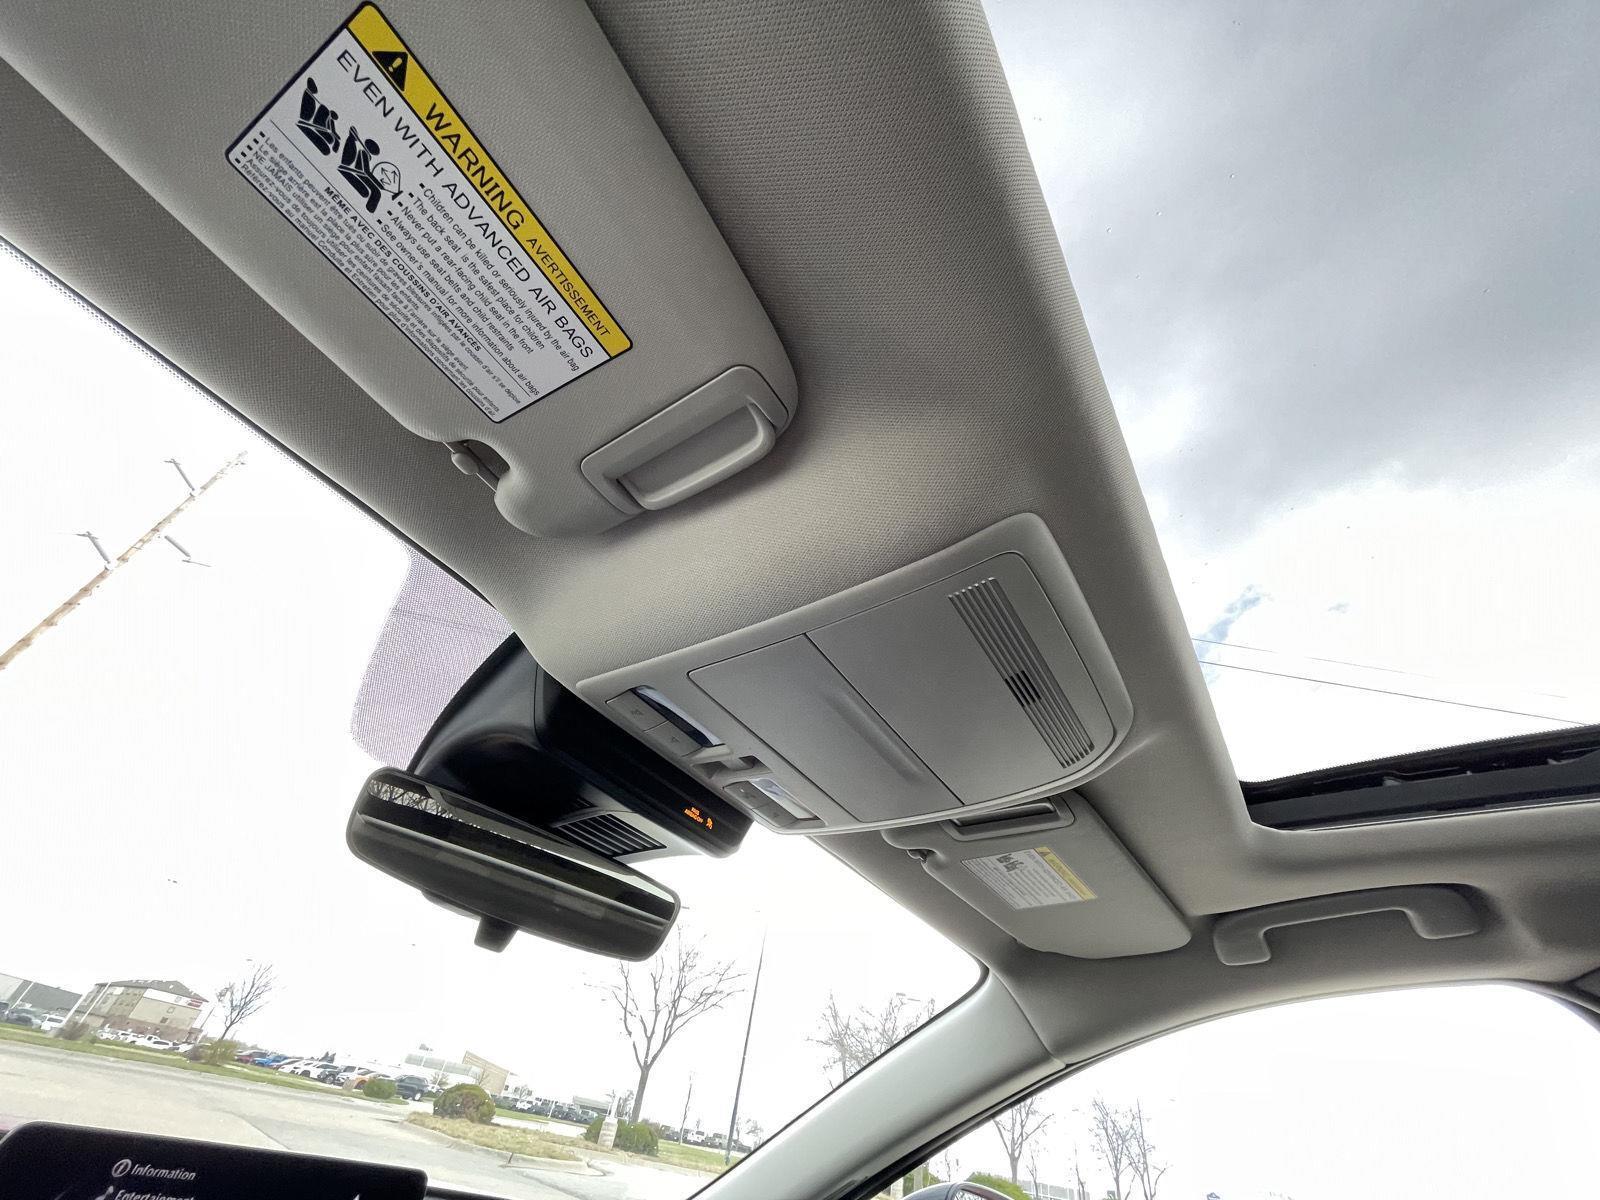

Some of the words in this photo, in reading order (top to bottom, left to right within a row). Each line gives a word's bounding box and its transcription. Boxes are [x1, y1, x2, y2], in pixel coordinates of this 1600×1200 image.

[251, 150, 266, 165] NE
[264, 162, 293, 192] JAMAIS
[335, 48, 395, 119] EVEN
[390, 116, 445, 178] WITH
[440, 177, 533, 284] ADVANCED
[527, 283, 559, 315] AIR
[553, 314, 595, 359] BAGS
[420, 102, 528, 230] WARNING
[524, 234, 611, 338] AVERTISSEMENT
[349, 213, 375, 240] AVEC
[373, 238, 393, 258] DES
[390, 257, 431, 298] COUSSINS
[428, 297, 450, 318] D'AIR
[379, 223, 398, 242] See
[394, 239, 425, 271] owner's
[421, 268, 449, 297] manual
[445, 294, 459, 307] for
[454, 305, 473, 324] more
[470, 321, 506, 357] information
[501, 355, 521, 374] about
[522, 380, 542, 397] bags
[387, 214, 419, 246] Always
[414, 243, 431, 260] use
[428, 257, 447, 276] seat
[443, 273, 463, 294] belts
[458, 291, 475, 307] and
[471, 304, 490, 323] child
[485, 321, 516, 351] restraints
[400, 205, 426, 232] Never
[420, 230, 438, 247] put
[437, 250, 478, 291] rear-facing
[473, 288, 492, 307] child
[488, 305, 506, 322] seat
[507, 326, 521, 339] the
[517, 337, 534, 354] front
[410, 196, 430, 217] The
[425, 213, 448, 236] back
[442, 233, 462, 253] seat
[466, 260, 482, 276] the
[477, 273, 501, 297] safest
[494, 294, 517, 317] place
[512, 313, 525, 325] for
[520, 323, 547, 350] children
[421, 187, 456, 224] Children
[450, 222, 467, 240] can
[464, 237, 478, 250] be
[473, 248, 495, 270] killed
[495, 276, 528, 311] seriously
[521, 307, 547, 333] injured
[540, 329, 555, 341] by
[549, 338, 564, 350] the
[564, 357, 581, 372] bag
[131, 1164, 196, 1180] Information
